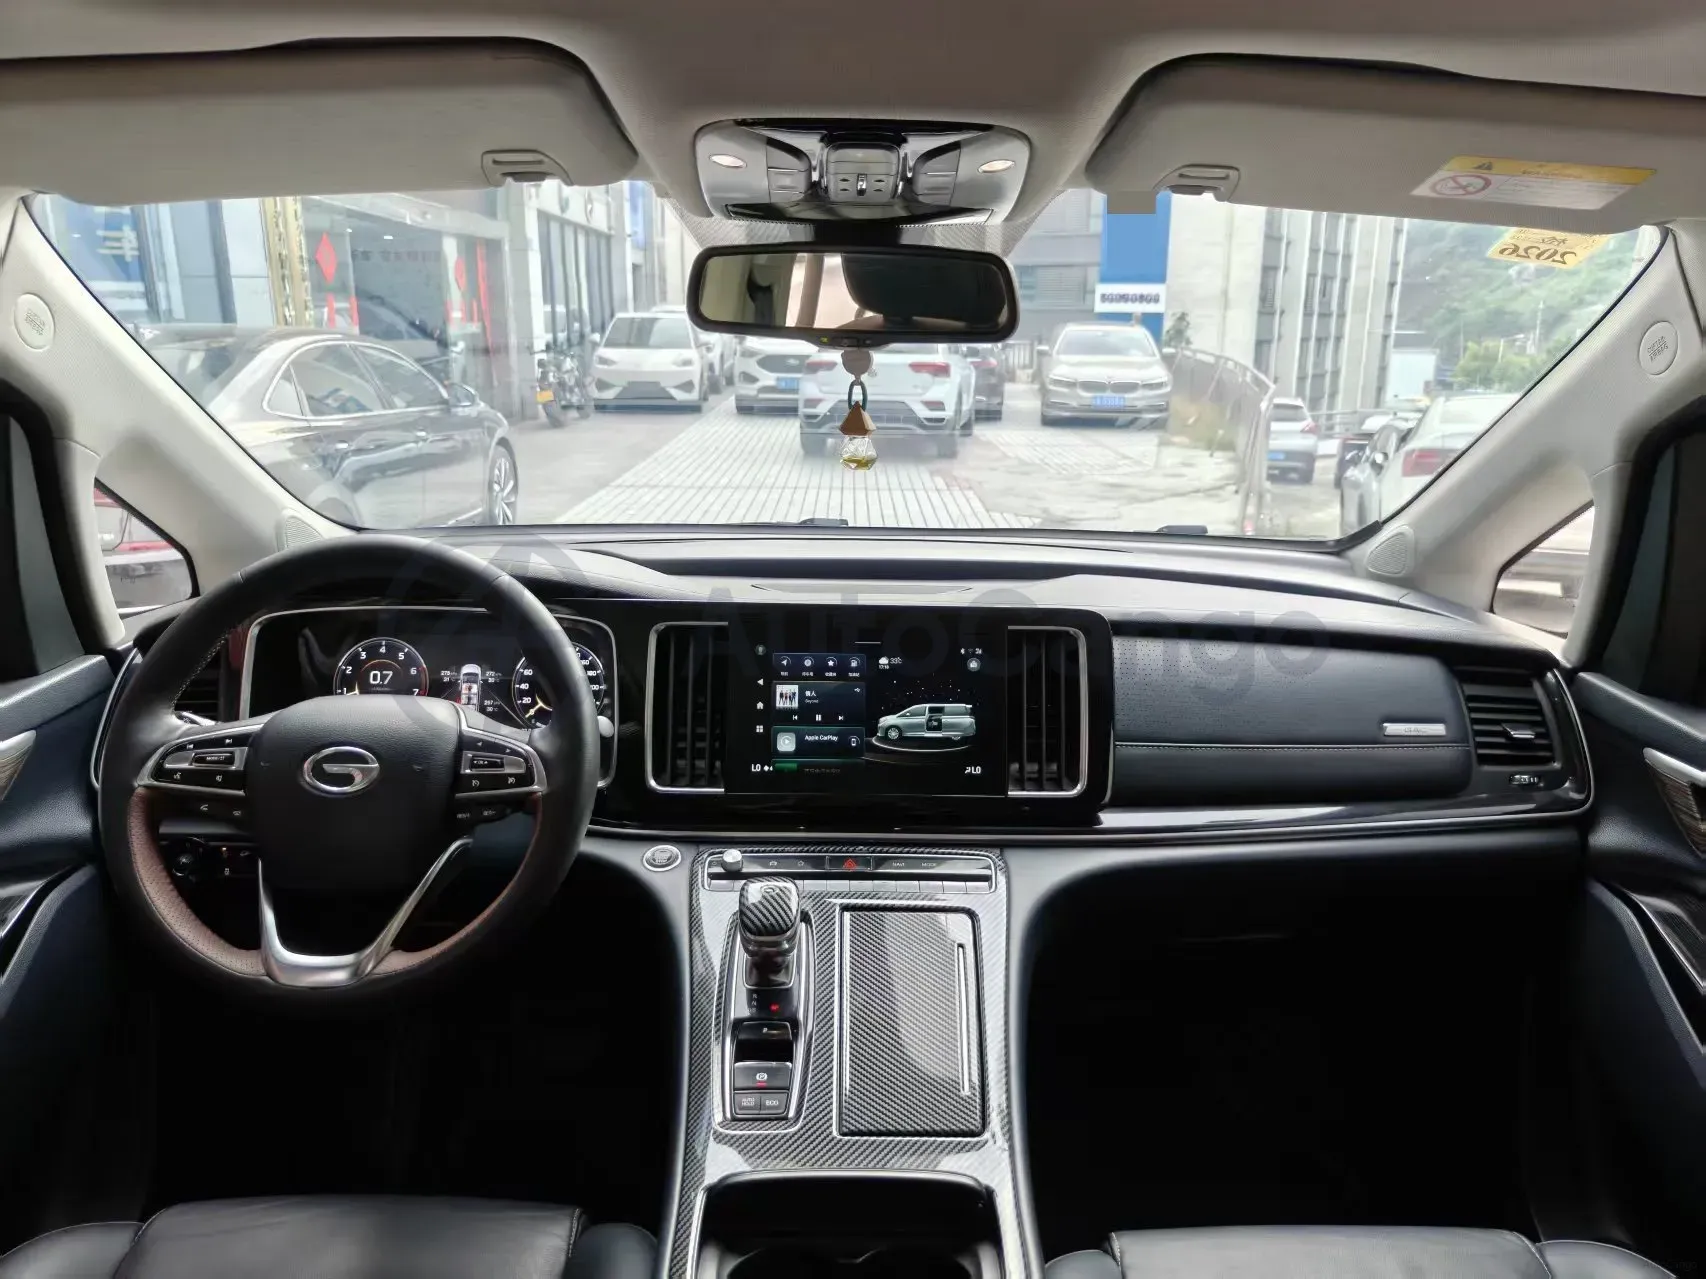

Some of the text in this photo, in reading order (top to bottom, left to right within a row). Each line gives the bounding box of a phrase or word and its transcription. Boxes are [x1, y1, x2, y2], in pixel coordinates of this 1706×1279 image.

[379, 645, 386, 653] 4
[398, 652, 405, 660] 5
[345, 666, 352, 674] 2
[369, 670, 393, 685] 0.7
[412, 688, 419, 696] 7
[819, 734, 838, 742] CarPlay
[751, 764, 761, 772] LO
[971, 766, 981, 774] LO
